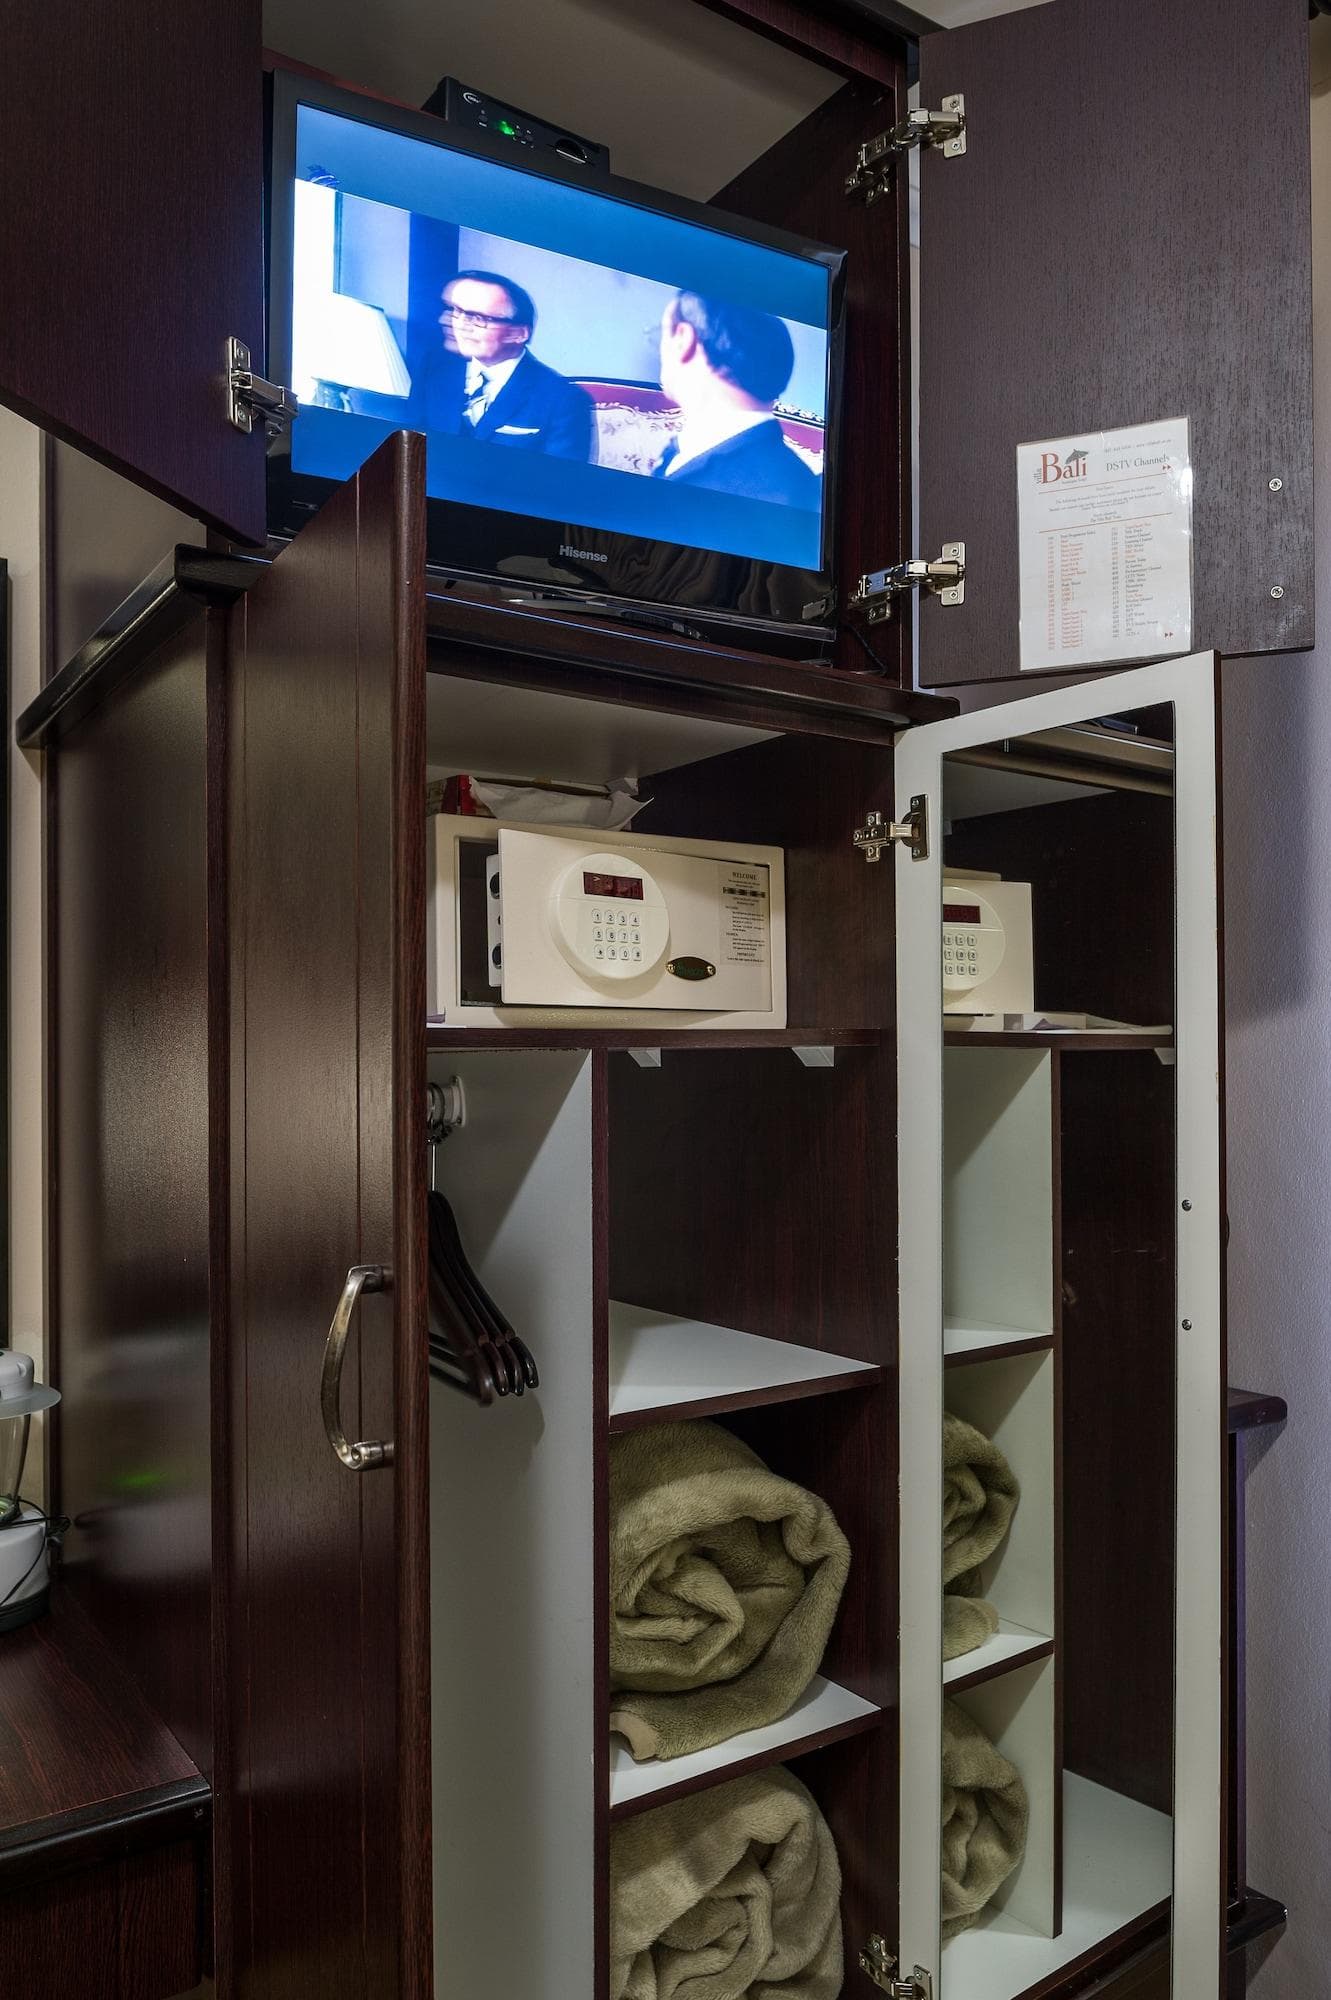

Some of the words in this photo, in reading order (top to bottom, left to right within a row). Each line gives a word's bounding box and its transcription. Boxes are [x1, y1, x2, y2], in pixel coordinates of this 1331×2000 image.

[1041, 452, 1087, 484] Bali
[1105, 459, 1131, 471] DSTV
[1133, 453, 1170, 467] Channels
[559, 544, 609, 563] Hisense
